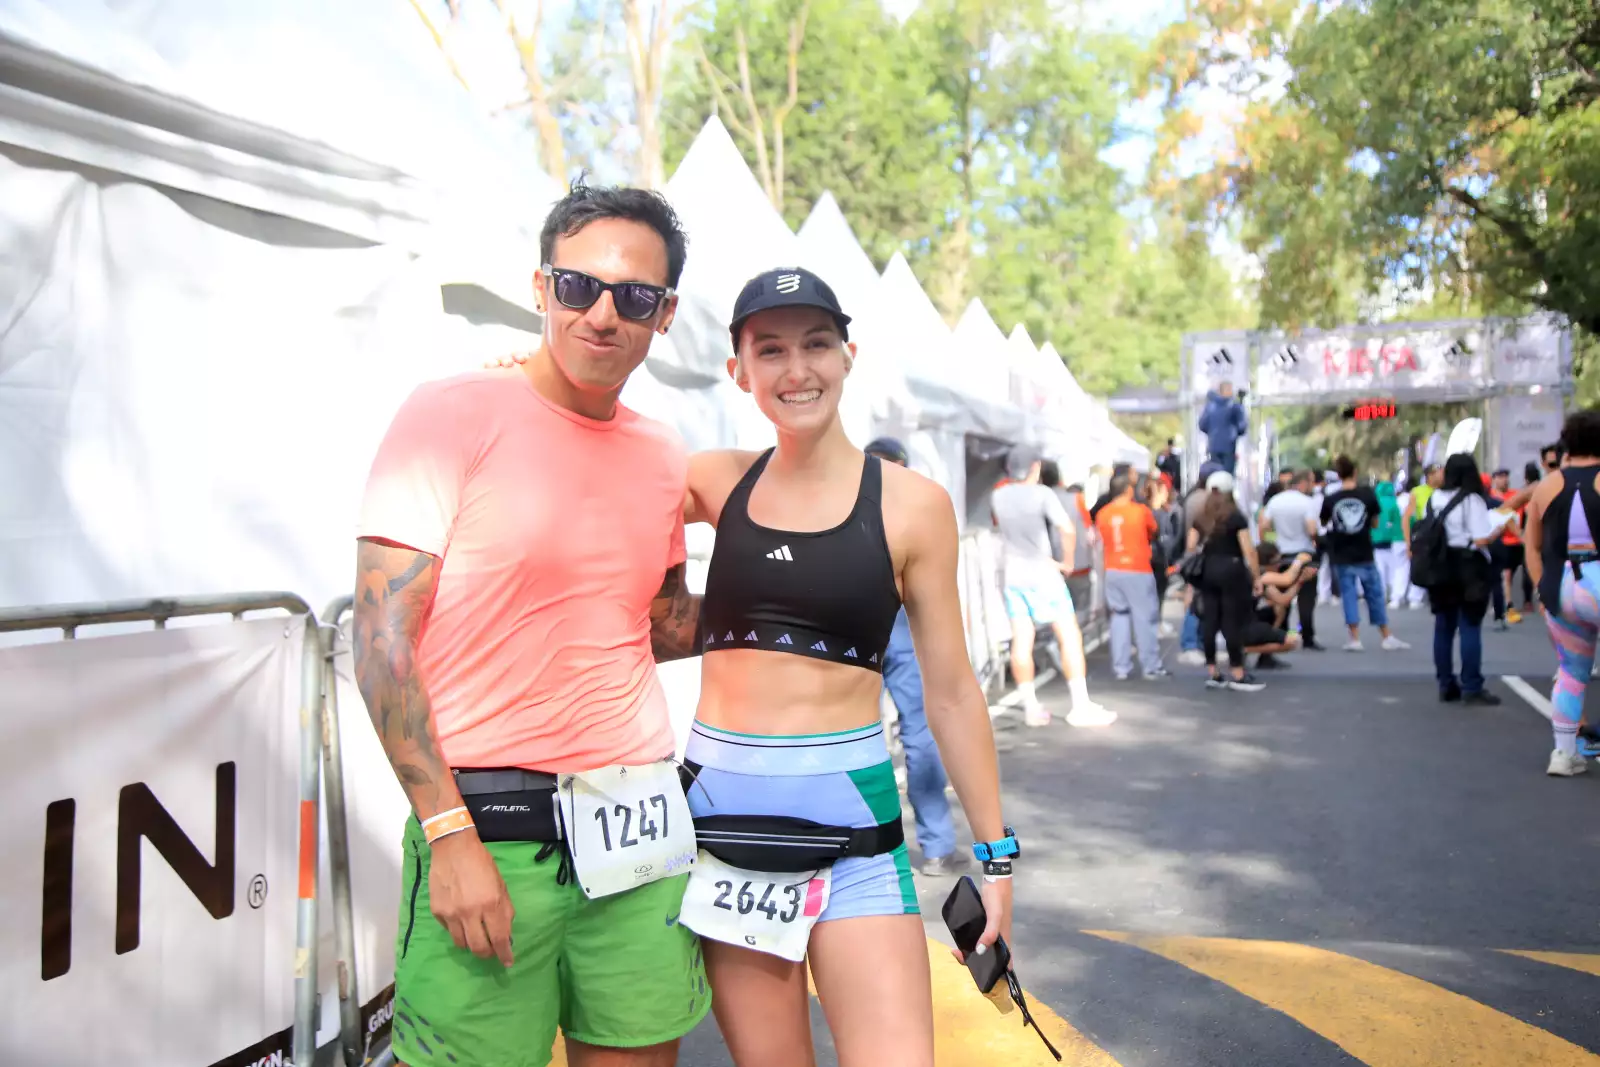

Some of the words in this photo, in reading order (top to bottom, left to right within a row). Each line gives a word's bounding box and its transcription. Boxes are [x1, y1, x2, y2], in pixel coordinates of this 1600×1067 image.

[594, 793, 669, 852] 1247
[713, 880, 802, 923] 2643
[368, 998, 395, 1033] GRU
